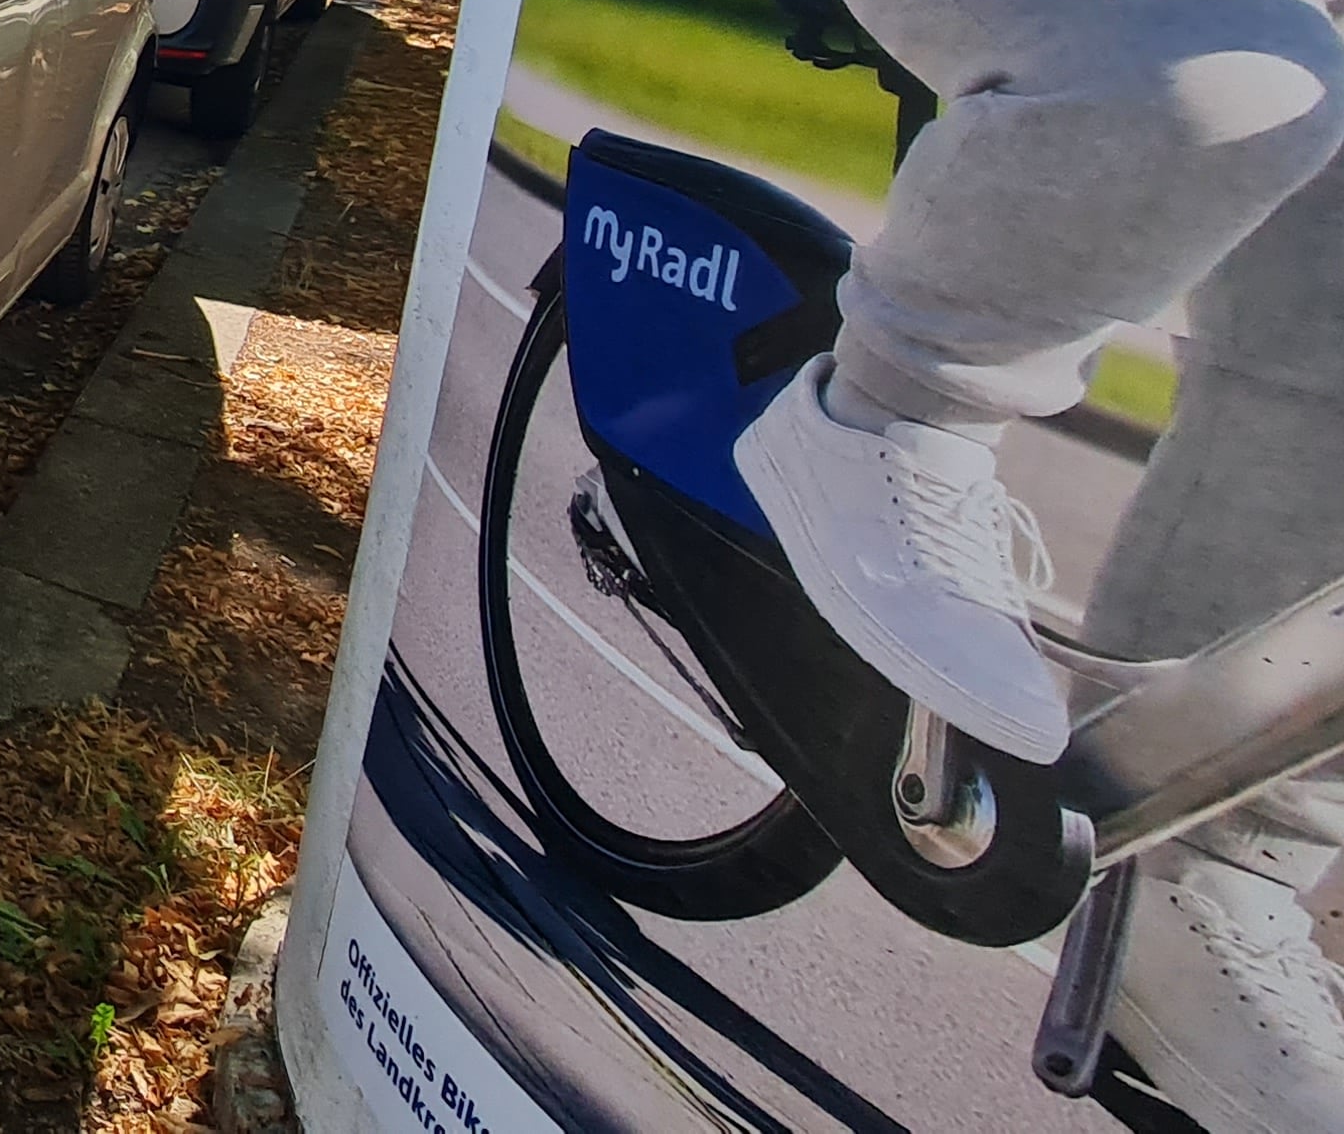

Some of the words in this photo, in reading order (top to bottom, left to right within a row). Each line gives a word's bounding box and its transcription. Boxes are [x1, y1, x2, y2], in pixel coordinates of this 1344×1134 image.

[583, 205, 740, 312] myRadl
[340, 979, 366, 1030] des
[348, 938, 437, 1083] Offizielles
